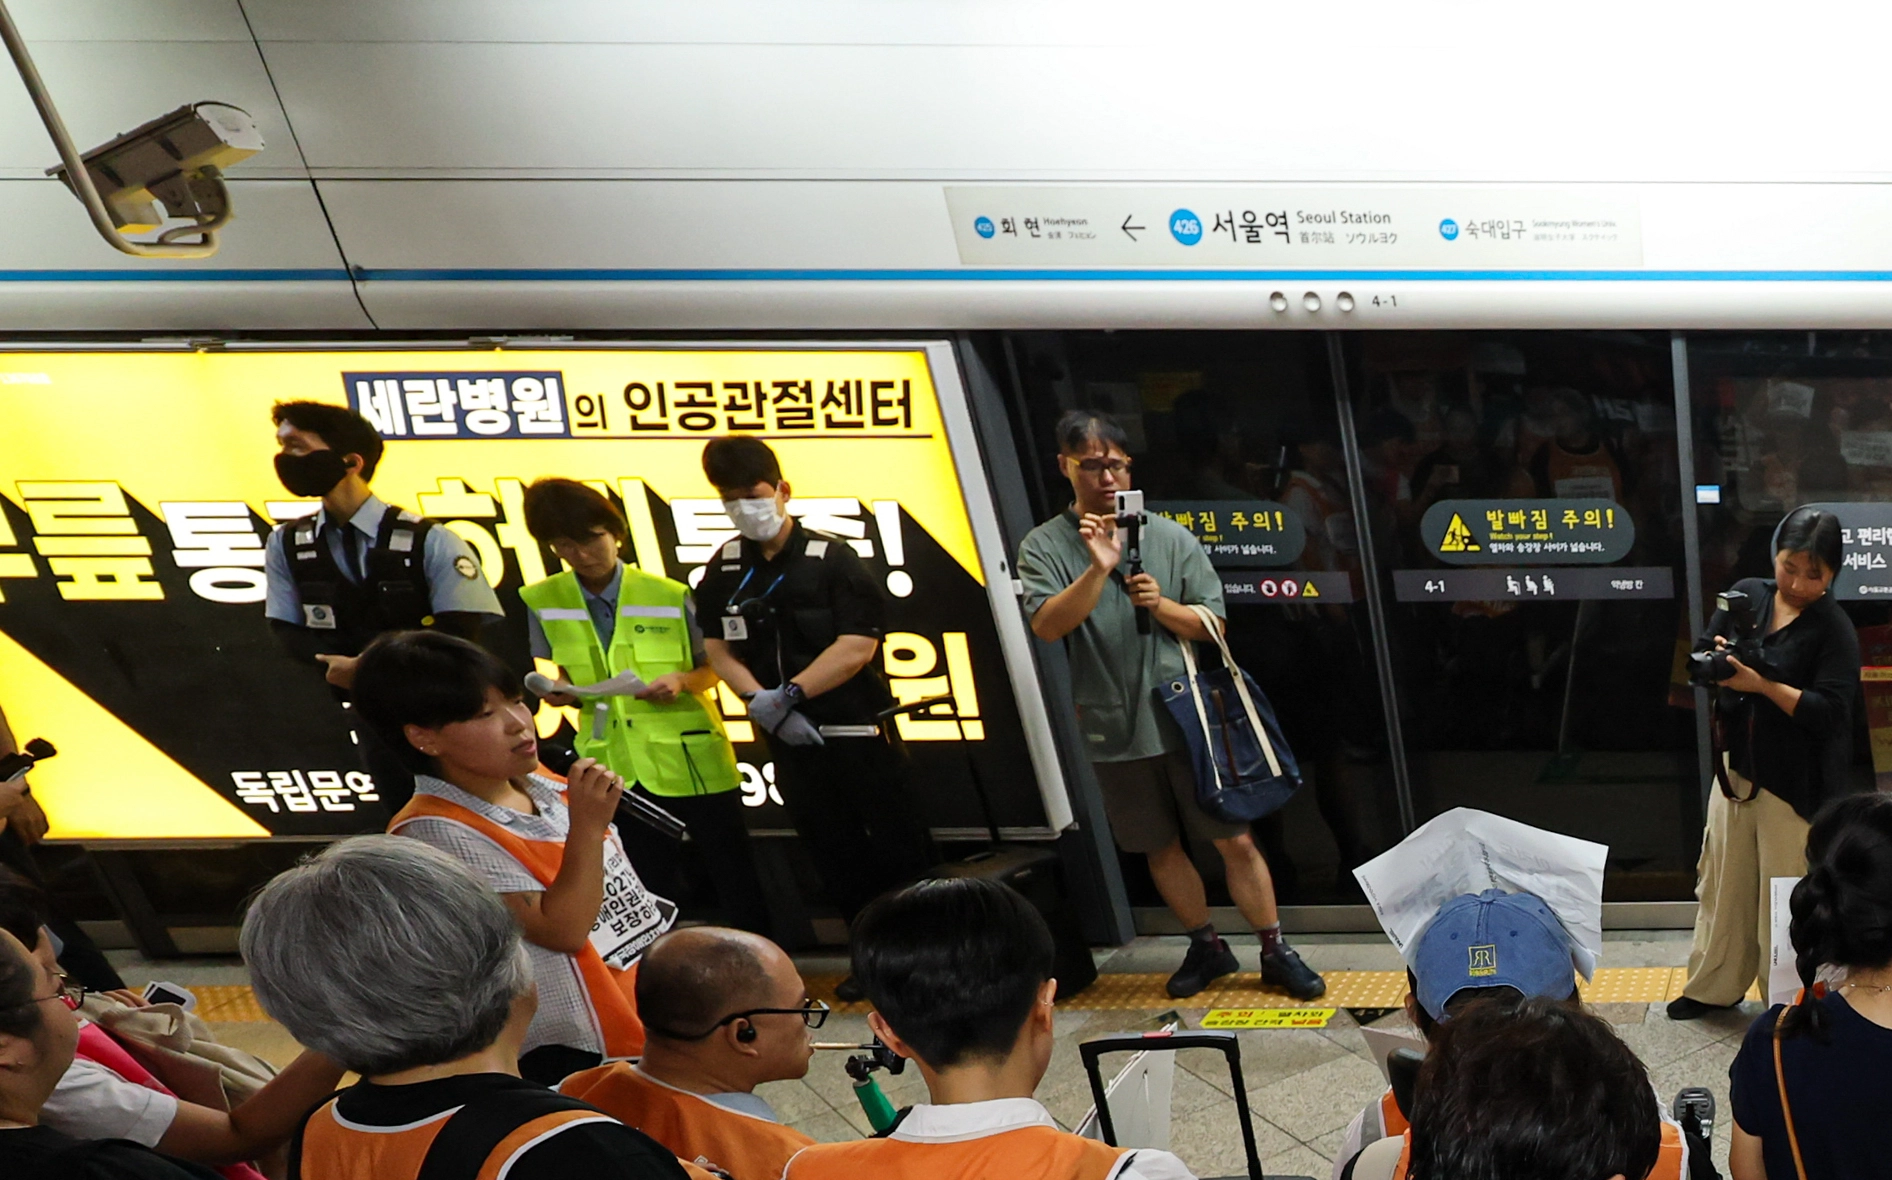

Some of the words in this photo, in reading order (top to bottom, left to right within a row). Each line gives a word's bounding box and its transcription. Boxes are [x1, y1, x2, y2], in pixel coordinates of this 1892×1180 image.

[1173, 218, 1200, 236] 426
[1211, 209, 1291, 245] 서울역
[1296, 210, 1336, 224] Seoul
[1340, 210, 1392, 224] Station
[1464, 219, 1527, 241] 숙대입구
[1371, 294, 1398, 308] 4-1
[622, 378, 914, 433] 인공관절센터
[1230, 510, 1285, 532] 주의!
[1486, 508, 1549, 531] 발빠짐
[1561, 508, 1615, 530] 주의!
[1842, 551, 1888, 571] 서비스
[1424, 579, 1446, 594] 4-1
